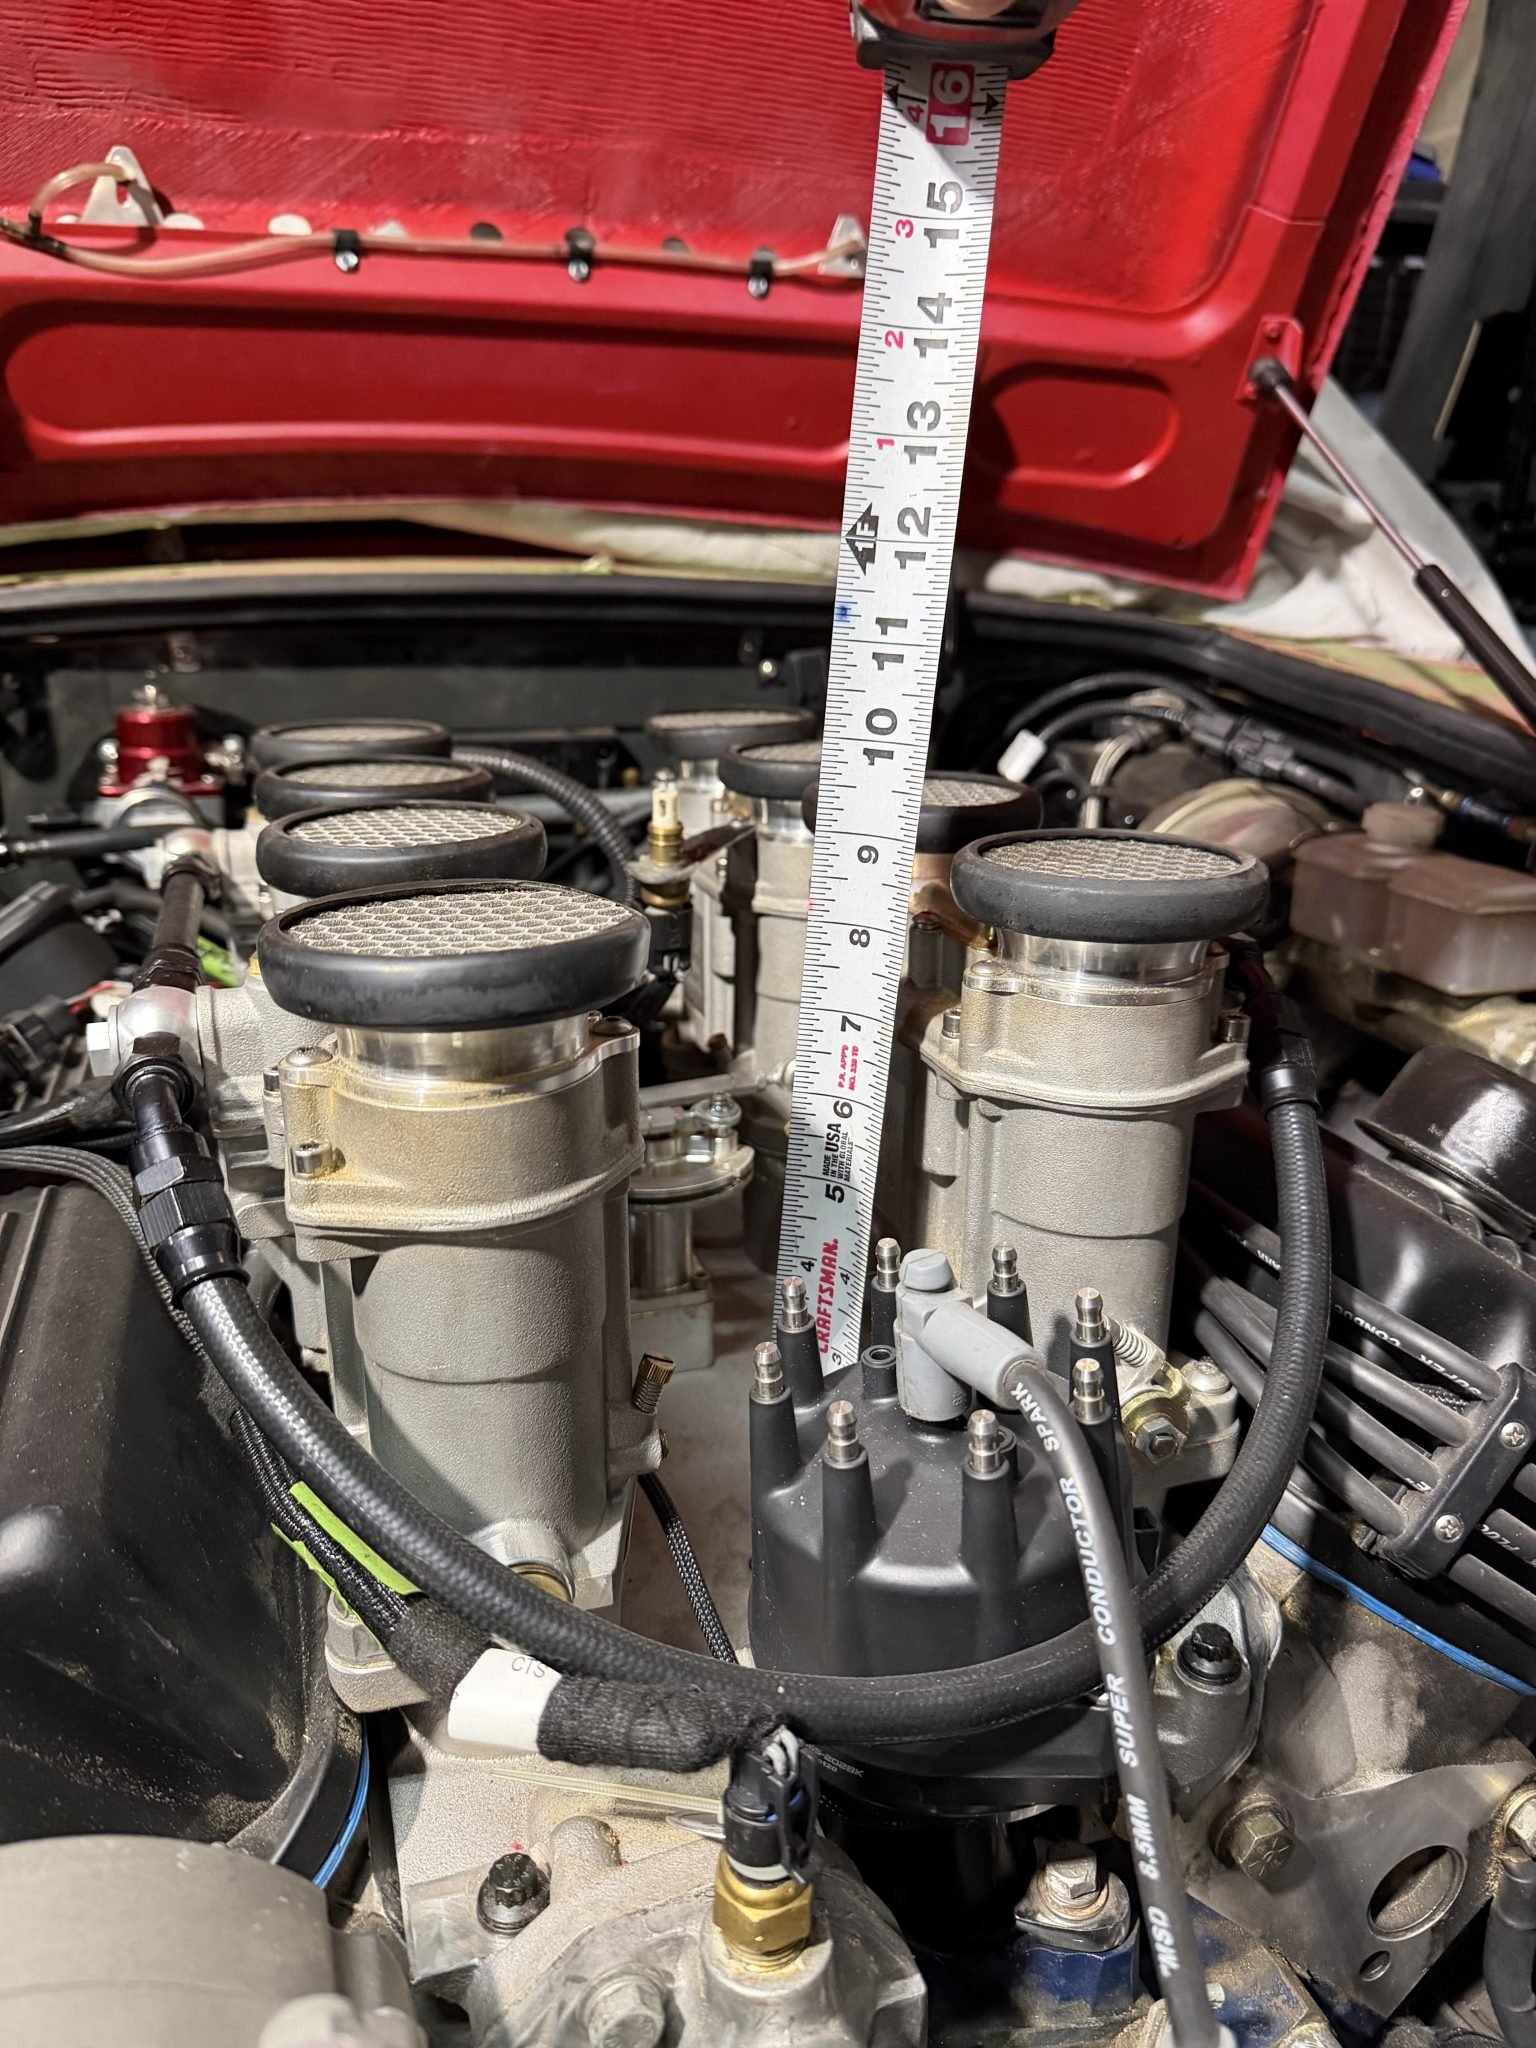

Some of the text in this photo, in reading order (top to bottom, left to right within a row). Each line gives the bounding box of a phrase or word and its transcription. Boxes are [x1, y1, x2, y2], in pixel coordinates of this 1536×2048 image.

[907, 105, 924, 123] 4
[928, 69, 970, 138] 16
[924, 181, 963, 249] 15
[895, 218, 914, 238] 3
[913, 292, 952, 358] 14
[884, 330, 904, 349] 2
[876, 438, 895, 450] 1
[903, 400, 941, 465] 13
[893, 506, 931, 570] 12
[872, 616, 908, 670] 11
[862, 708, 897, 765] 10
[857, 844, 879, 864] 9
[849, 928, 870, 948] 8
[840, 1015, 861, 1032] 7
[833, 1100, 853, 1119] 6
[823, 1123, 841, 1176] MADE USA
[837, 1131, 849, 1179] WITH GLOBAL
[830, 1153, 839, 1178] IN THE
[824, 1184, 845, 1203] 5
[800, 1260, 815, 1273] 4
[840, 1272, 850, 1285] 4
[832, 1352, 842, 1366] 3
[1009, 1380, 1061, 1453] SPARK
[1060, 1475, 1117, 1647] CONDUCTOR
[511, 1656, 545, 1678] CTS
[1105, 1674, 1139, 1768] SUPER
[1128, 1793, 1160, 1881] 8.5MM
